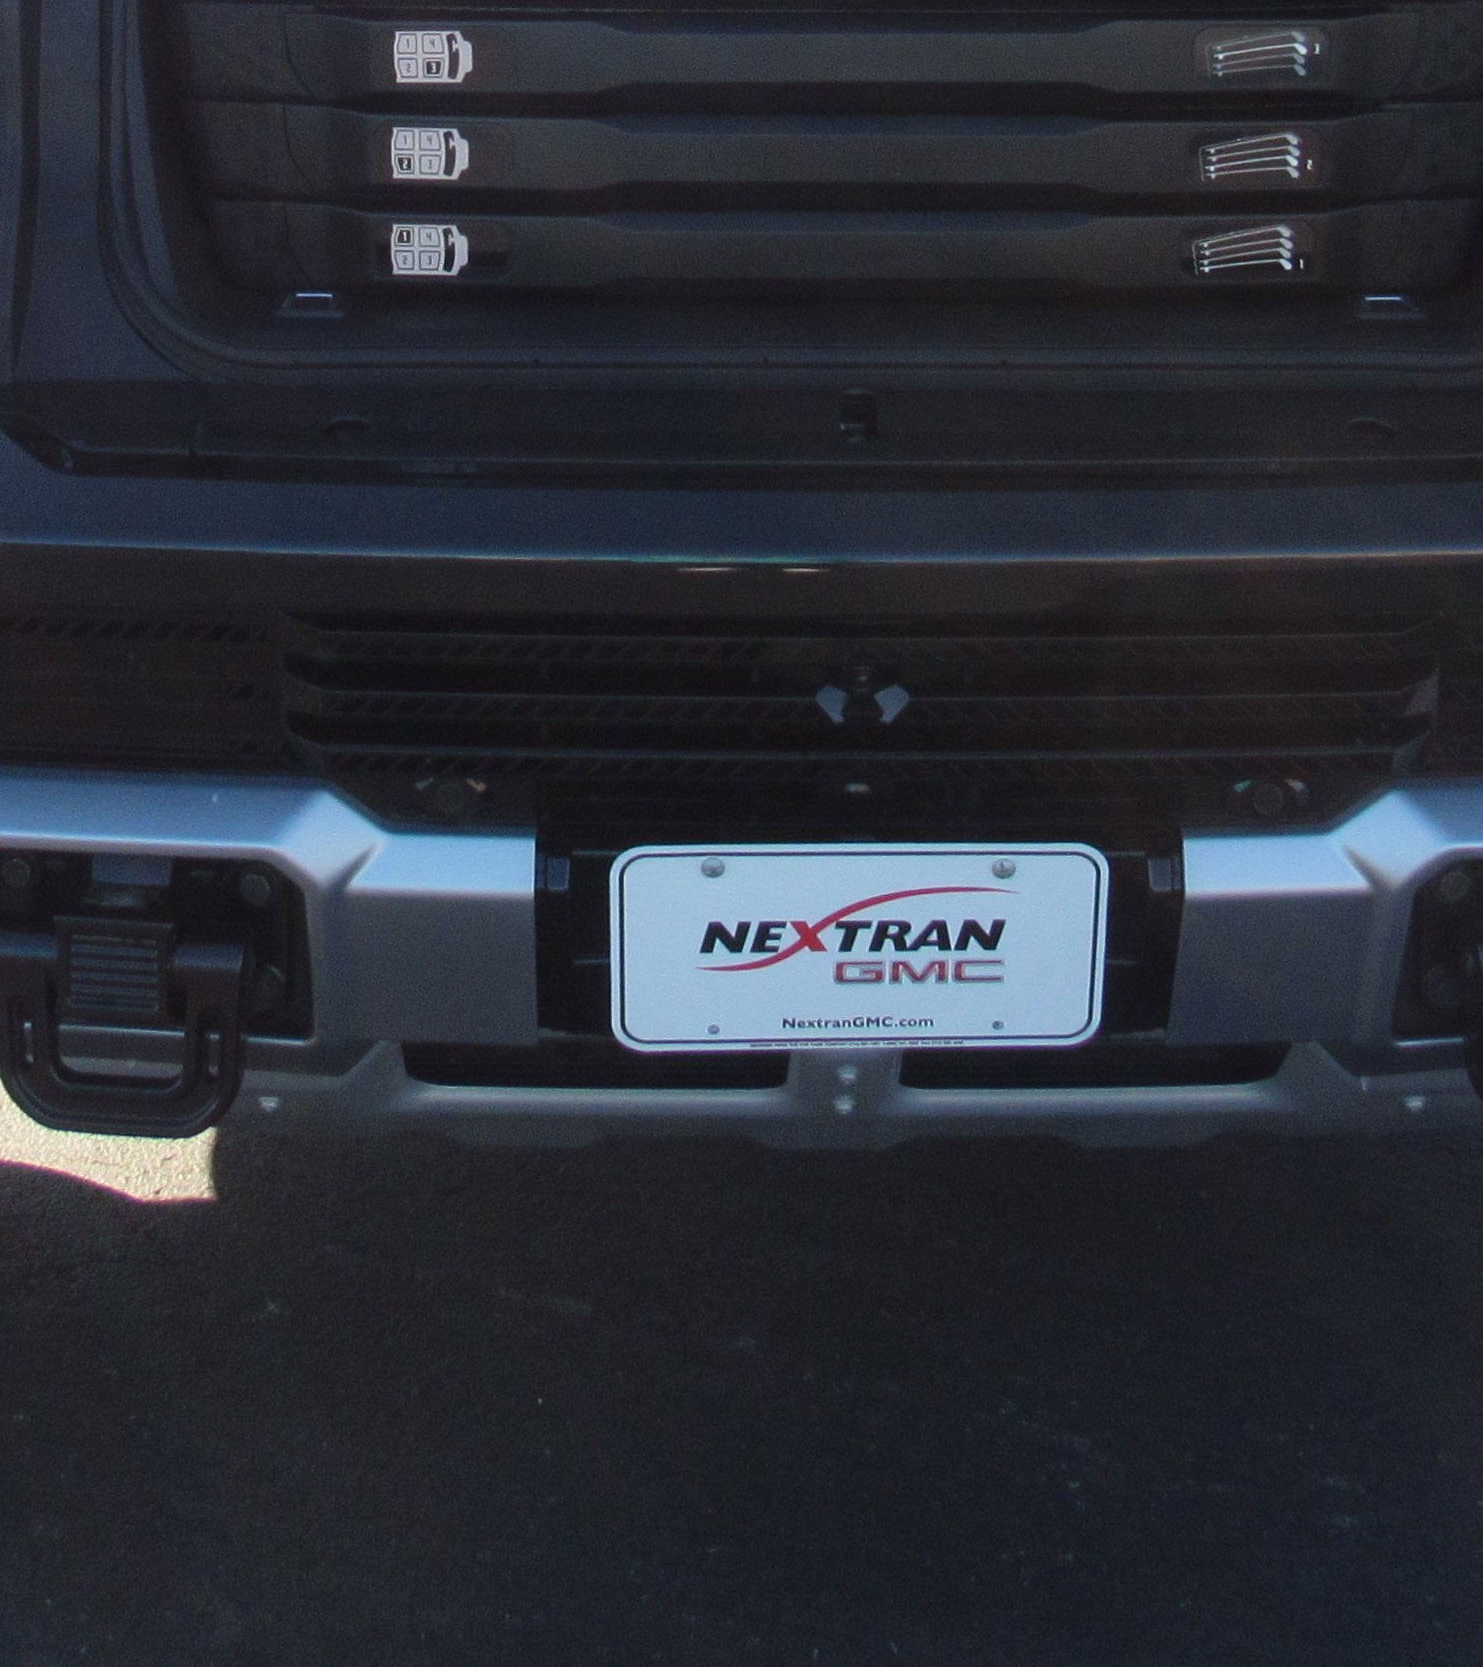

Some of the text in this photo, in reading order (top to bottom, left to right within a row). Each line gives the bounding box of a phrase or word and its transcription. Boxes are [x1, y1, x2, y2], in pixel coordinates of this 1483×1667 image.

[402, 158, 408, 169] 2
[699, 918, 1007, 954] NEXTRAN
[834, 959, 1005, 985] GMC
[781, 1016, 935, 1031] NextranGMC.com
